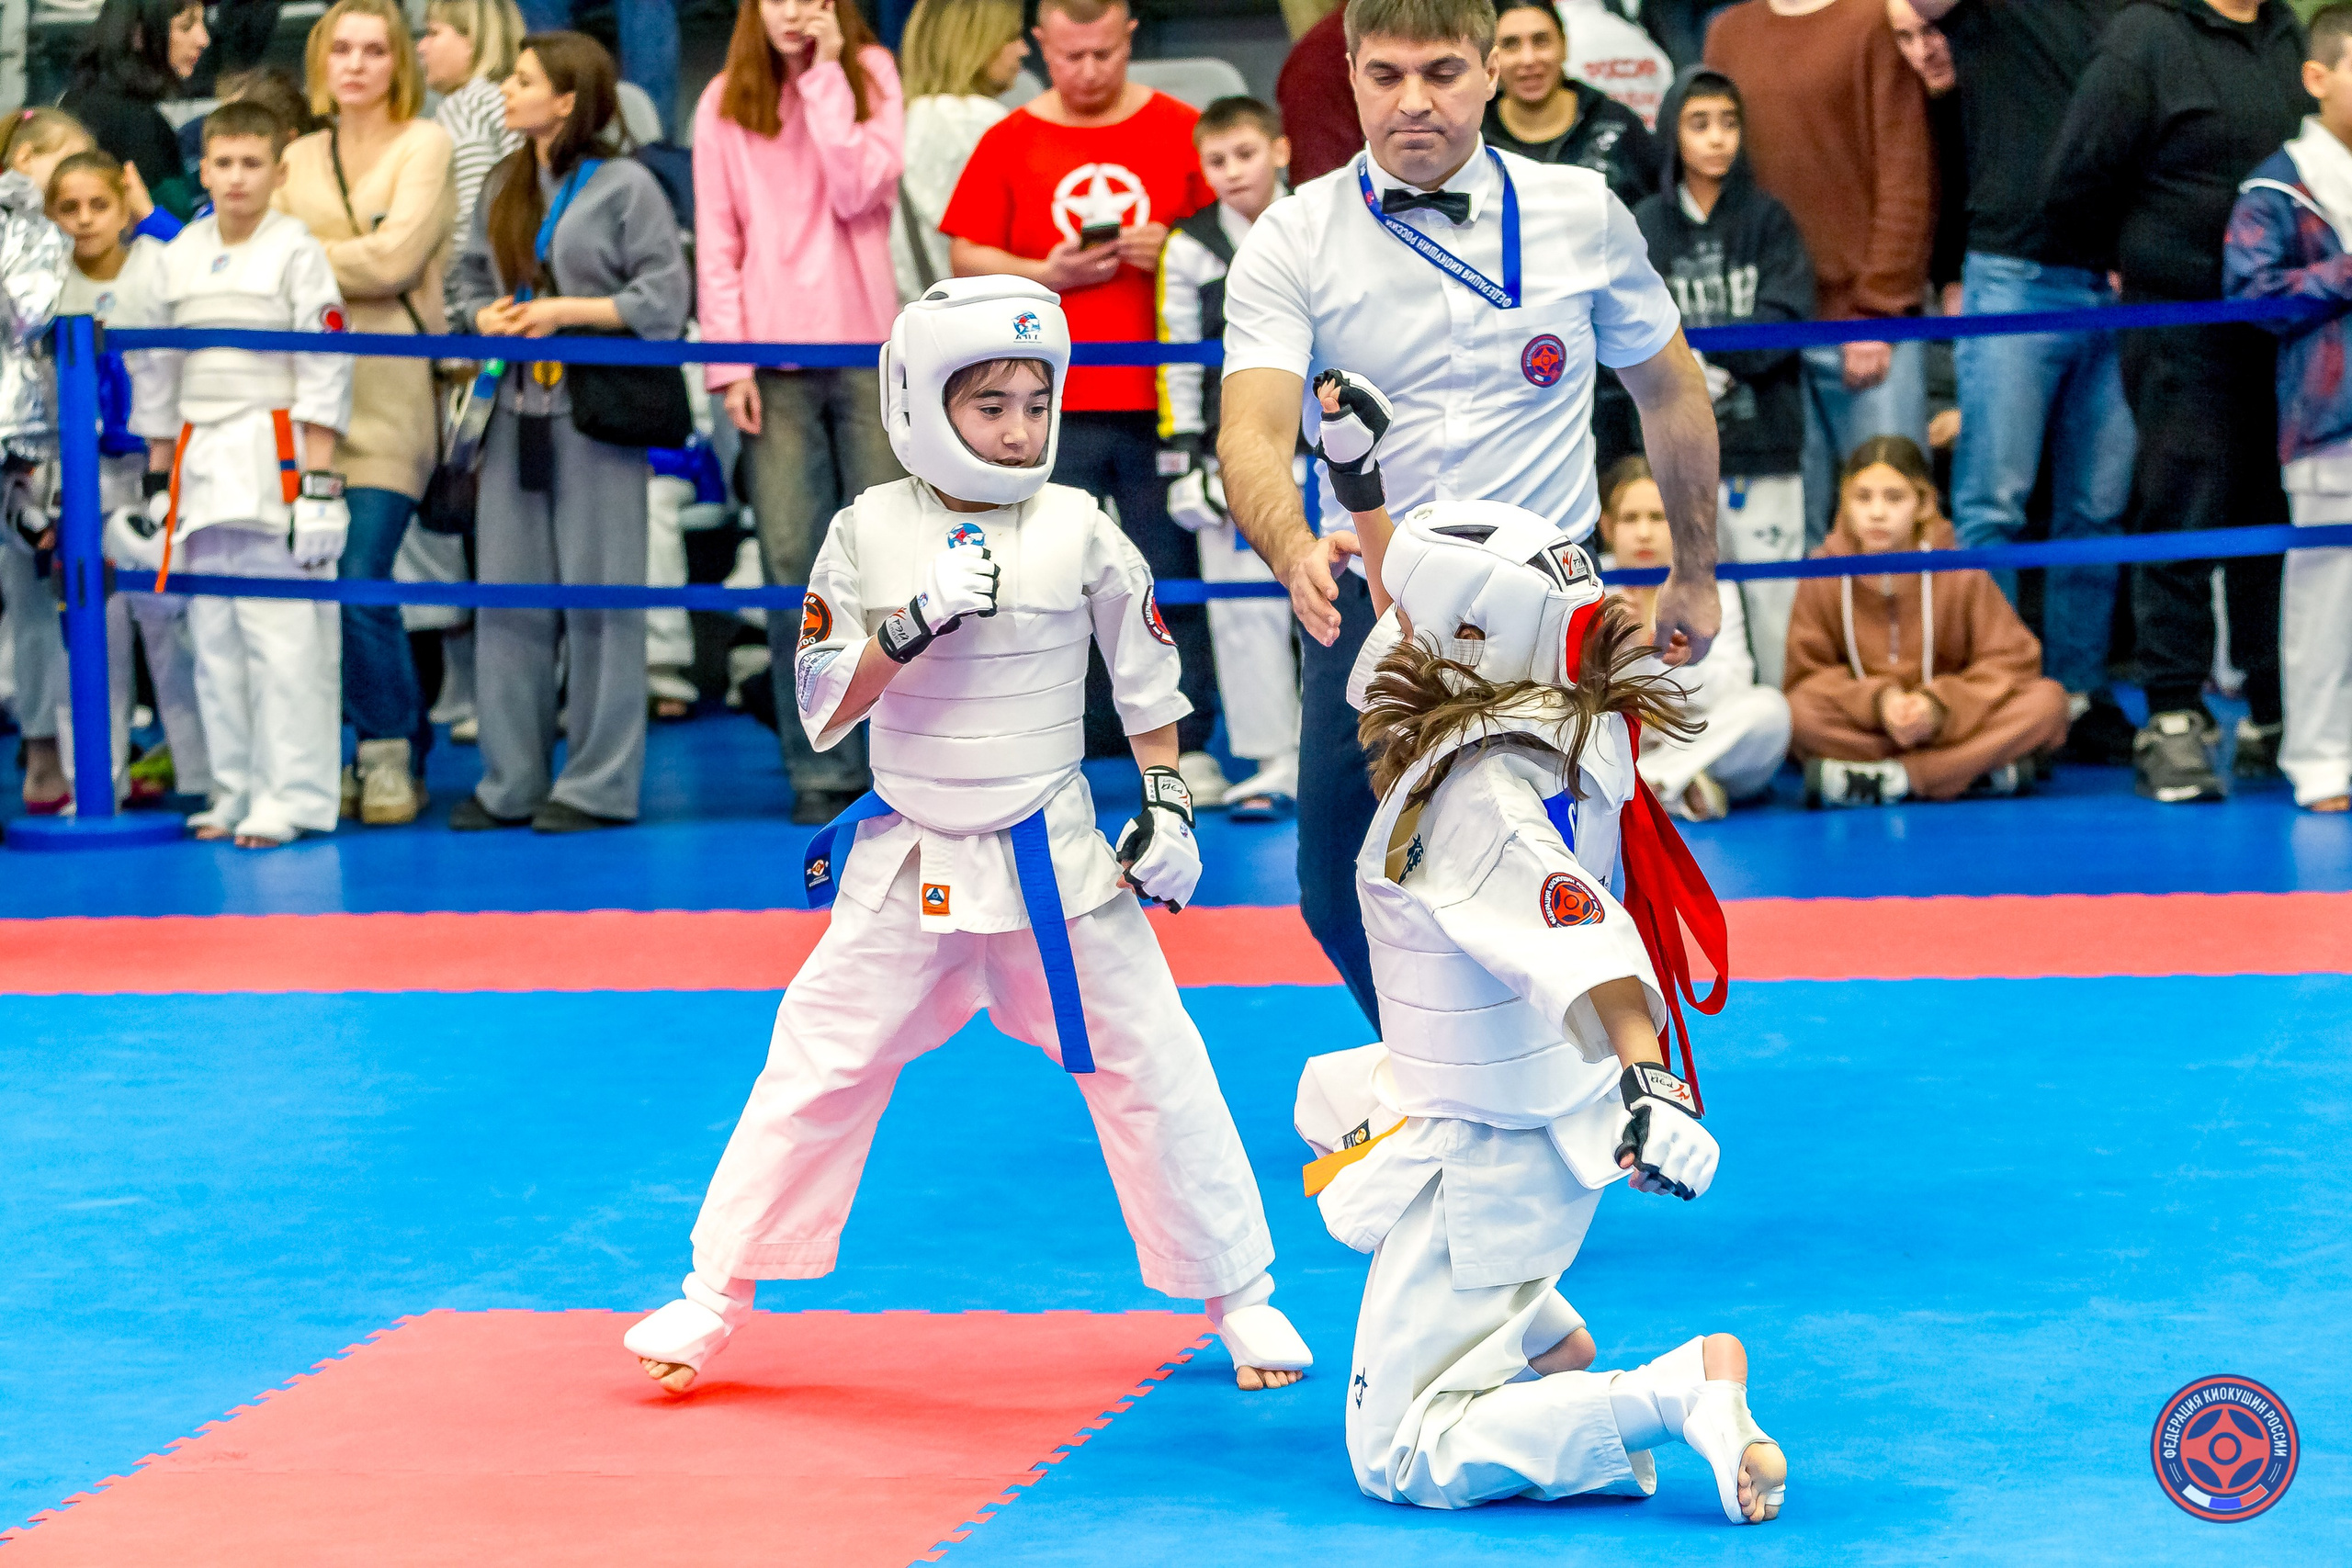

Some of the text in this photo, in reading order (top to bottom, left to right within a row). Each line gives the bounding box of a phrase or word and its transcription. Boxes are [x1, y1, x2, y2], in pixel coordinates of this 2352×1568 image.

[1385, 219, 1512, 308] ФЕДЕРАЦИЯ КИОКУШИН РОССИИ
